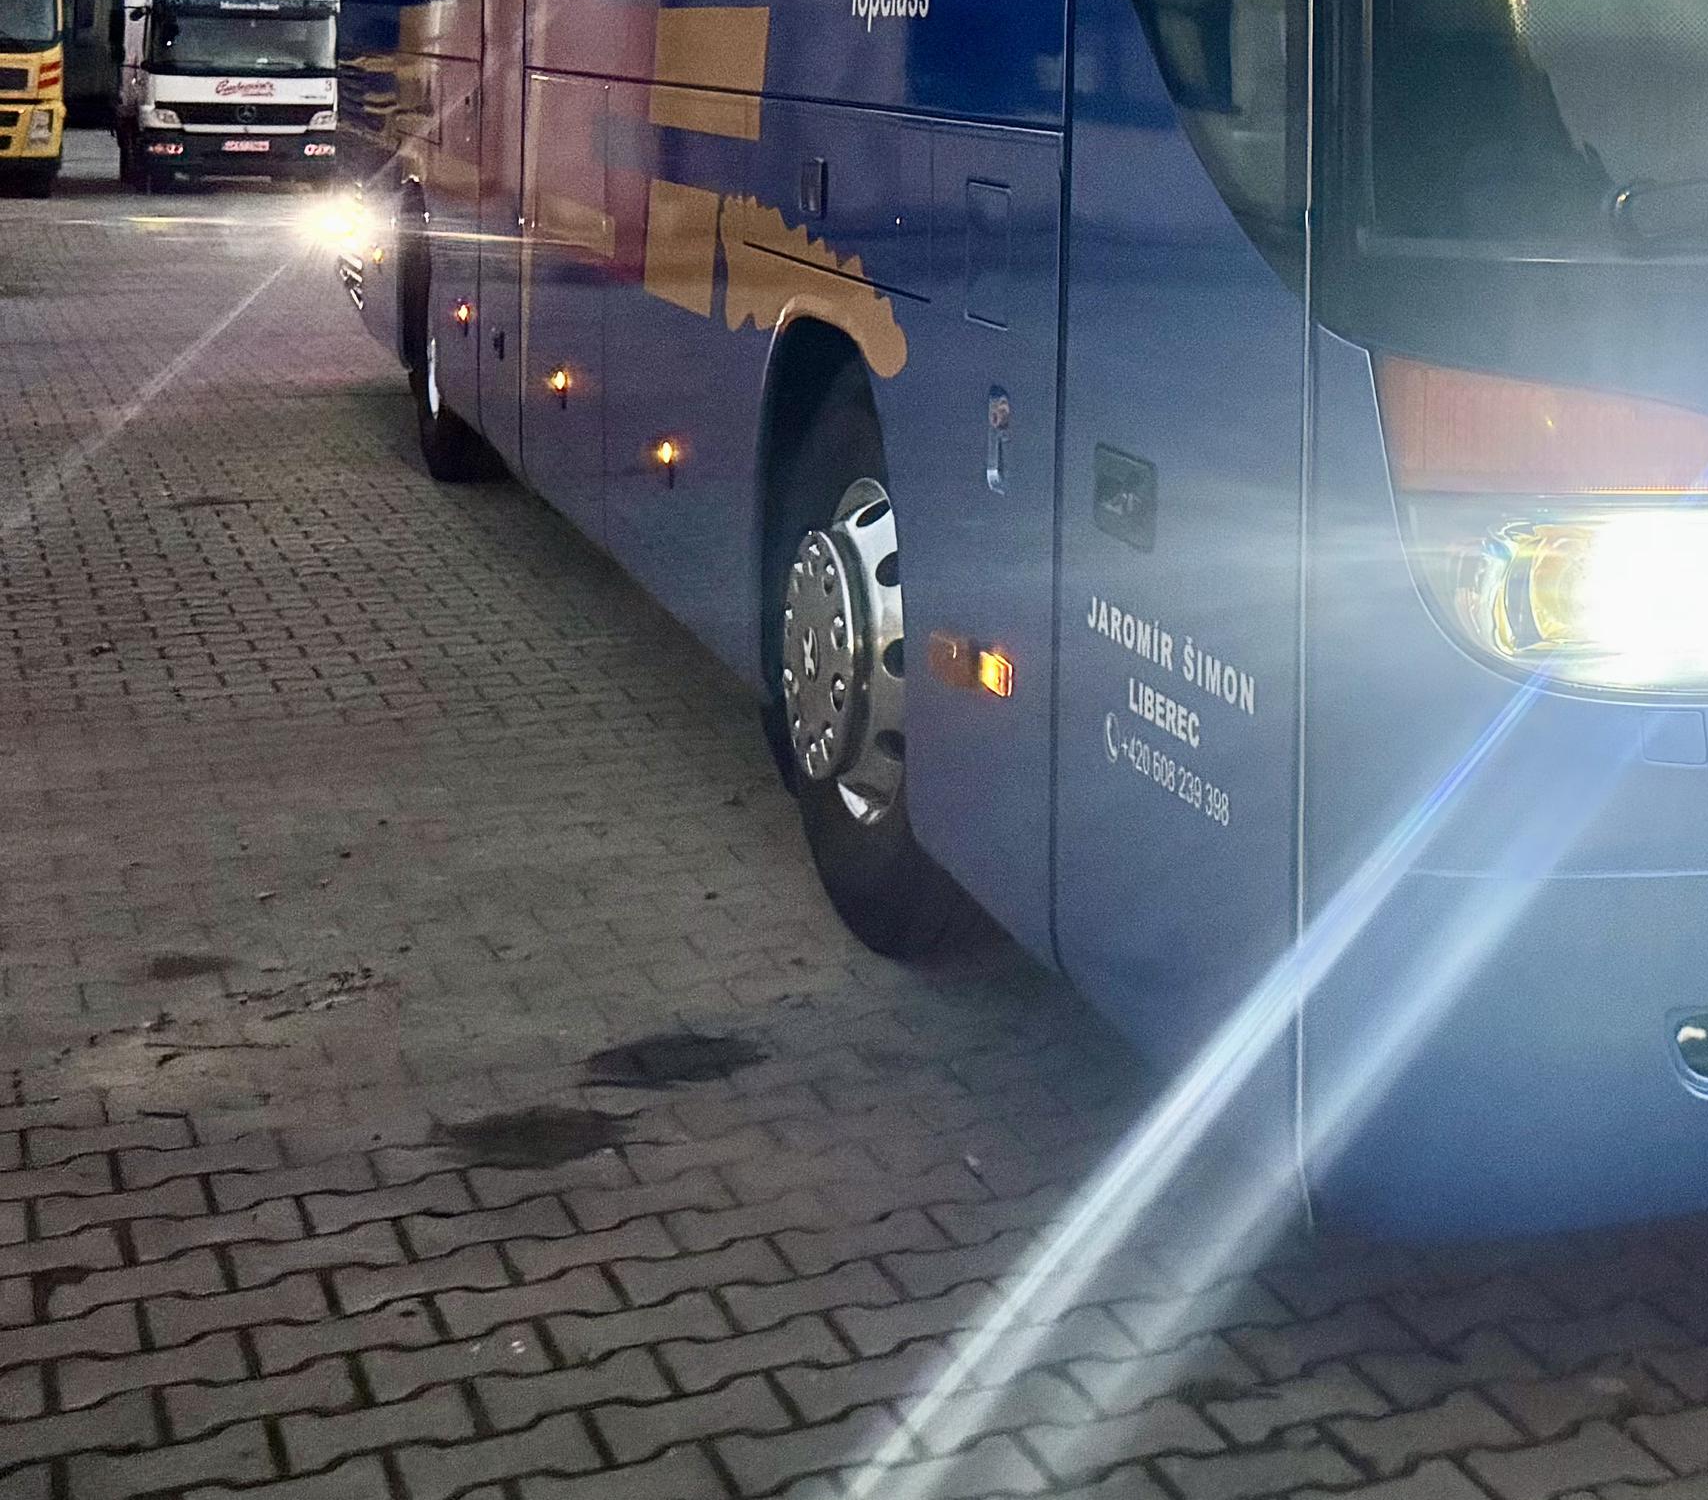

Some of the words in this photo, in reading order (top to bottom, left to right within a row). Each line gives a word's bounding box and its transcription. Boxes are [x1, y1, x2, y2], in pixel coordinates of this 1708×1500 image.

[1087, 596, 1173, 672] JAROMÍR
[1182, 635, 1255, 716] ŠIMON
[1128, 677, 1200, 749] LIBEREC
[1120, 735, 1150, 775] +420
[1178, 766, 1202, 808] 239
[1205, 782, 1230, 827] 398
